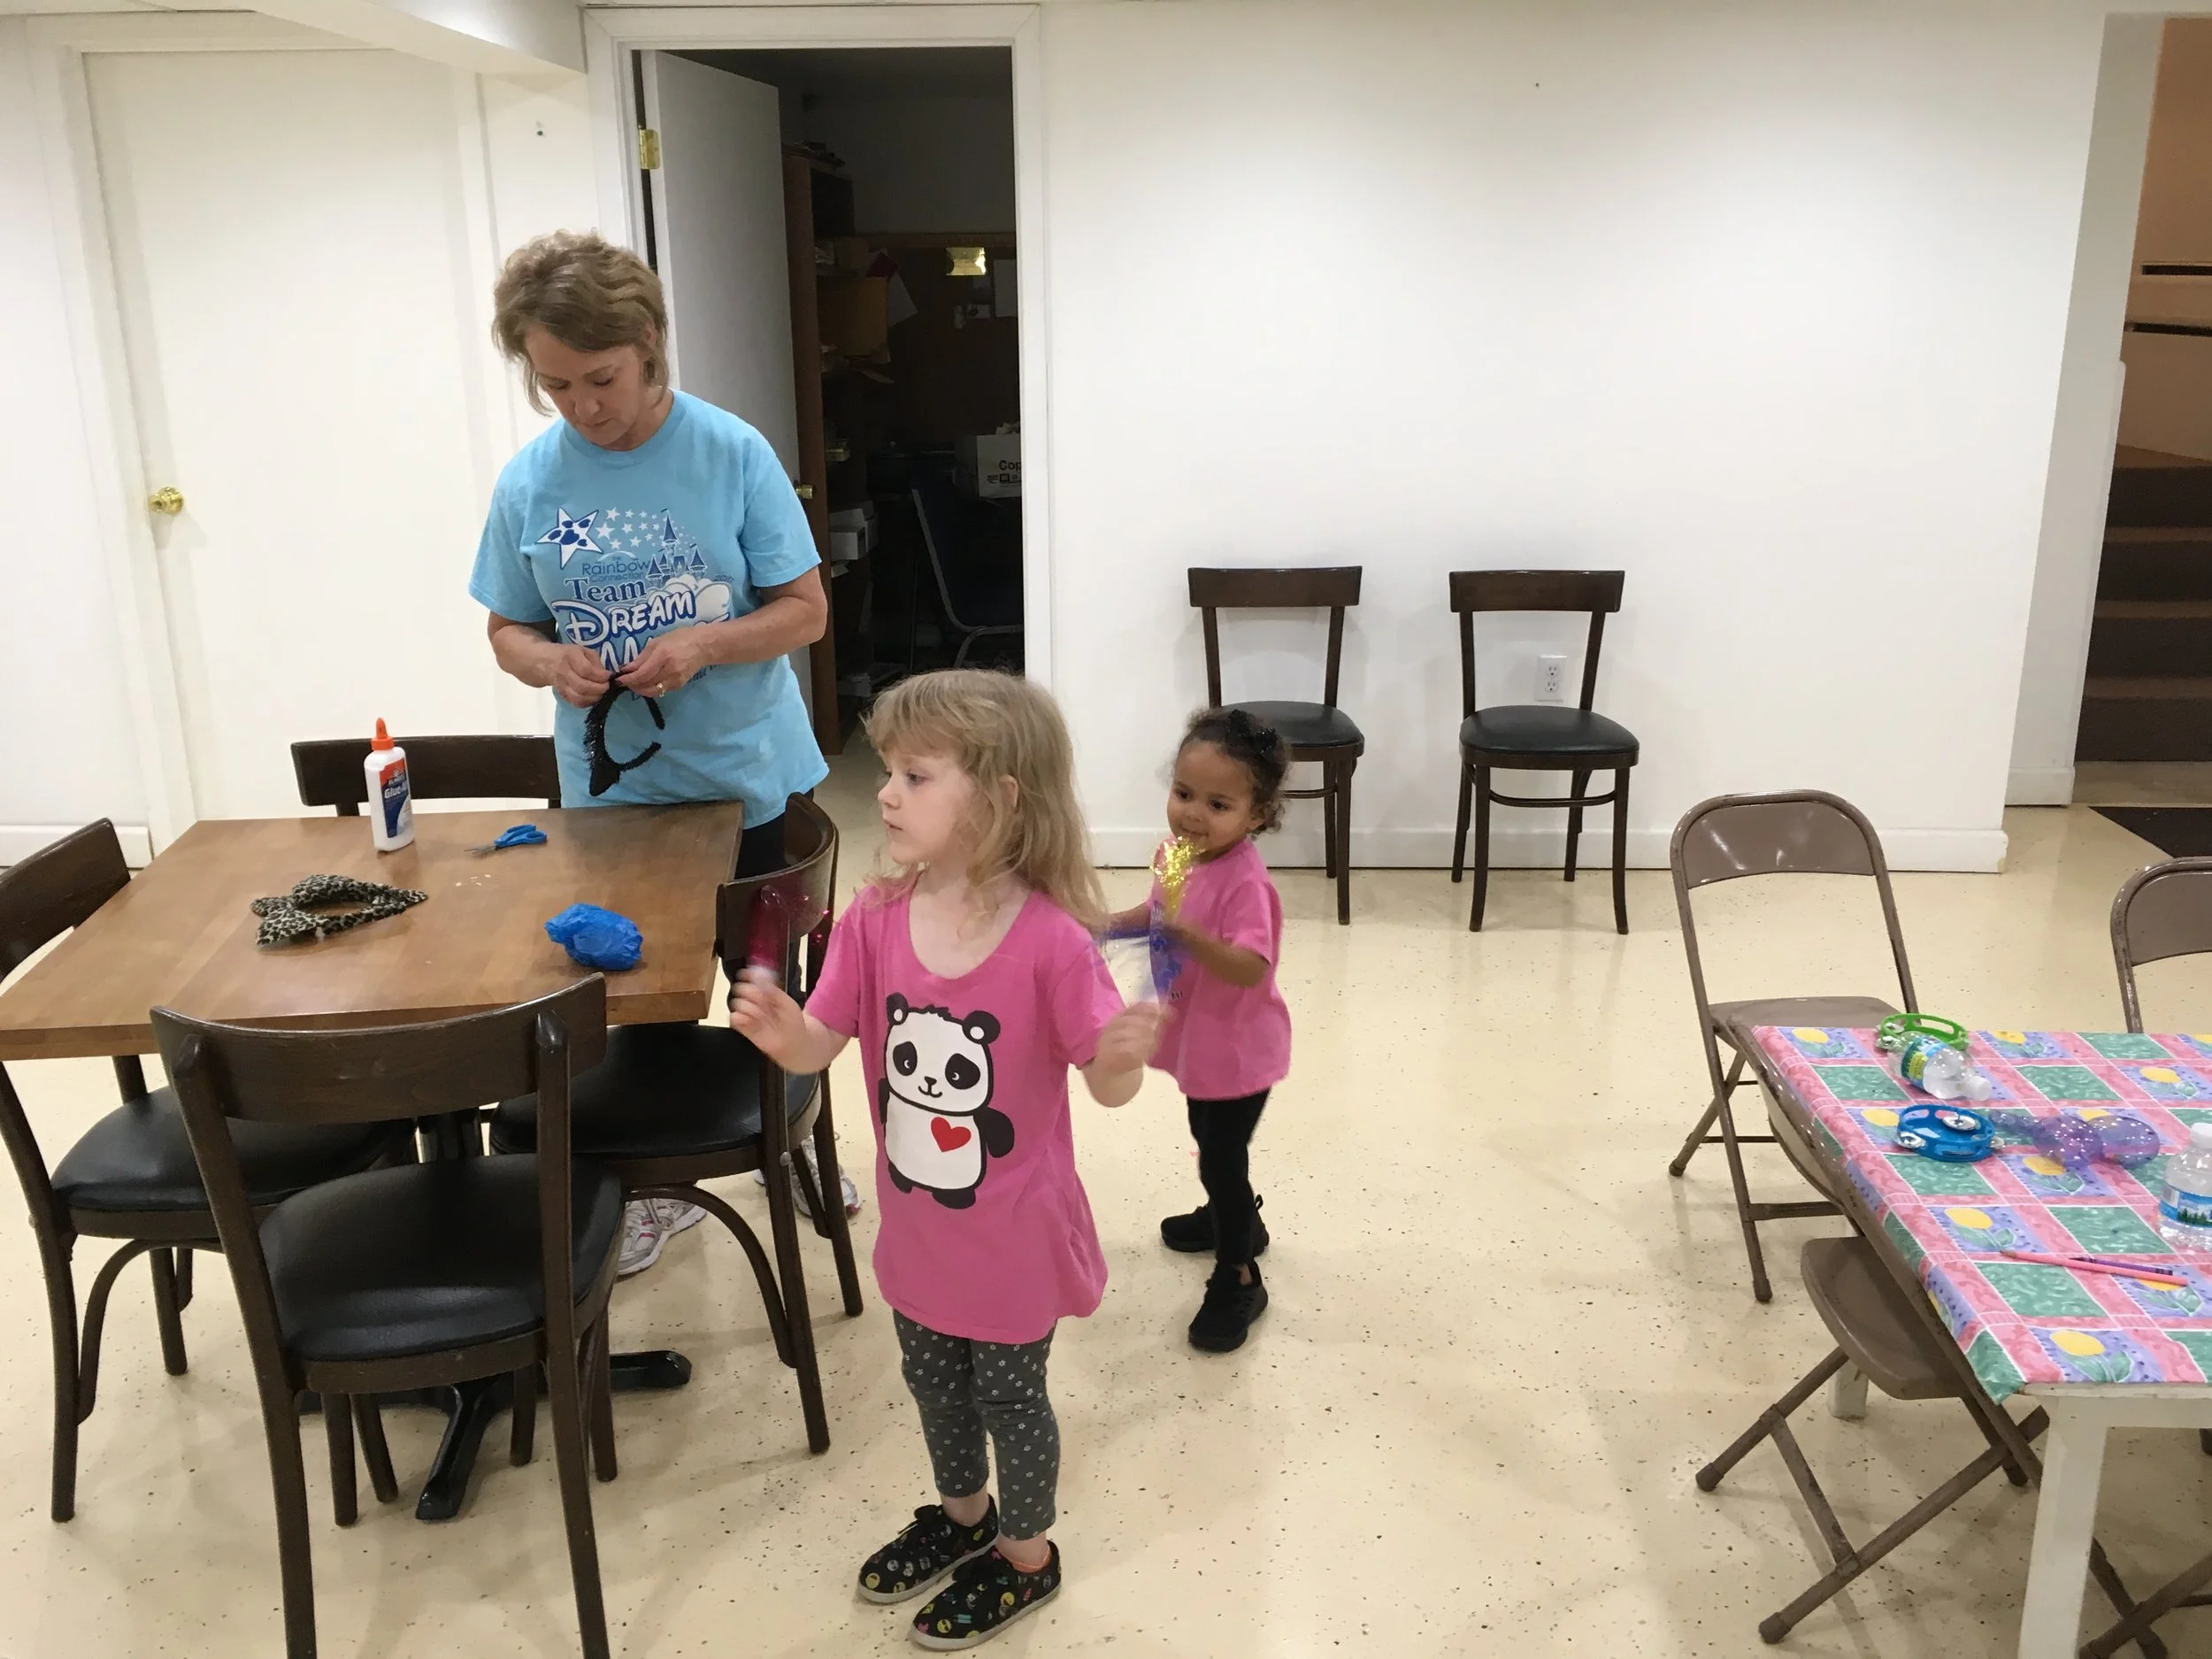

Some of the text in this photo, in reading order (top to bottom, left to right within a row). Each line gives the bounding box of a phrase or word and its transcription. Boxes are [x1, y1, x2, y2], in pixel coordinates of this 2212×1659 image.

[581, 560, 651, 576] Rainbow
[565, 577, 648, 603] Team
[551, 590, 696, 648] DREAM
